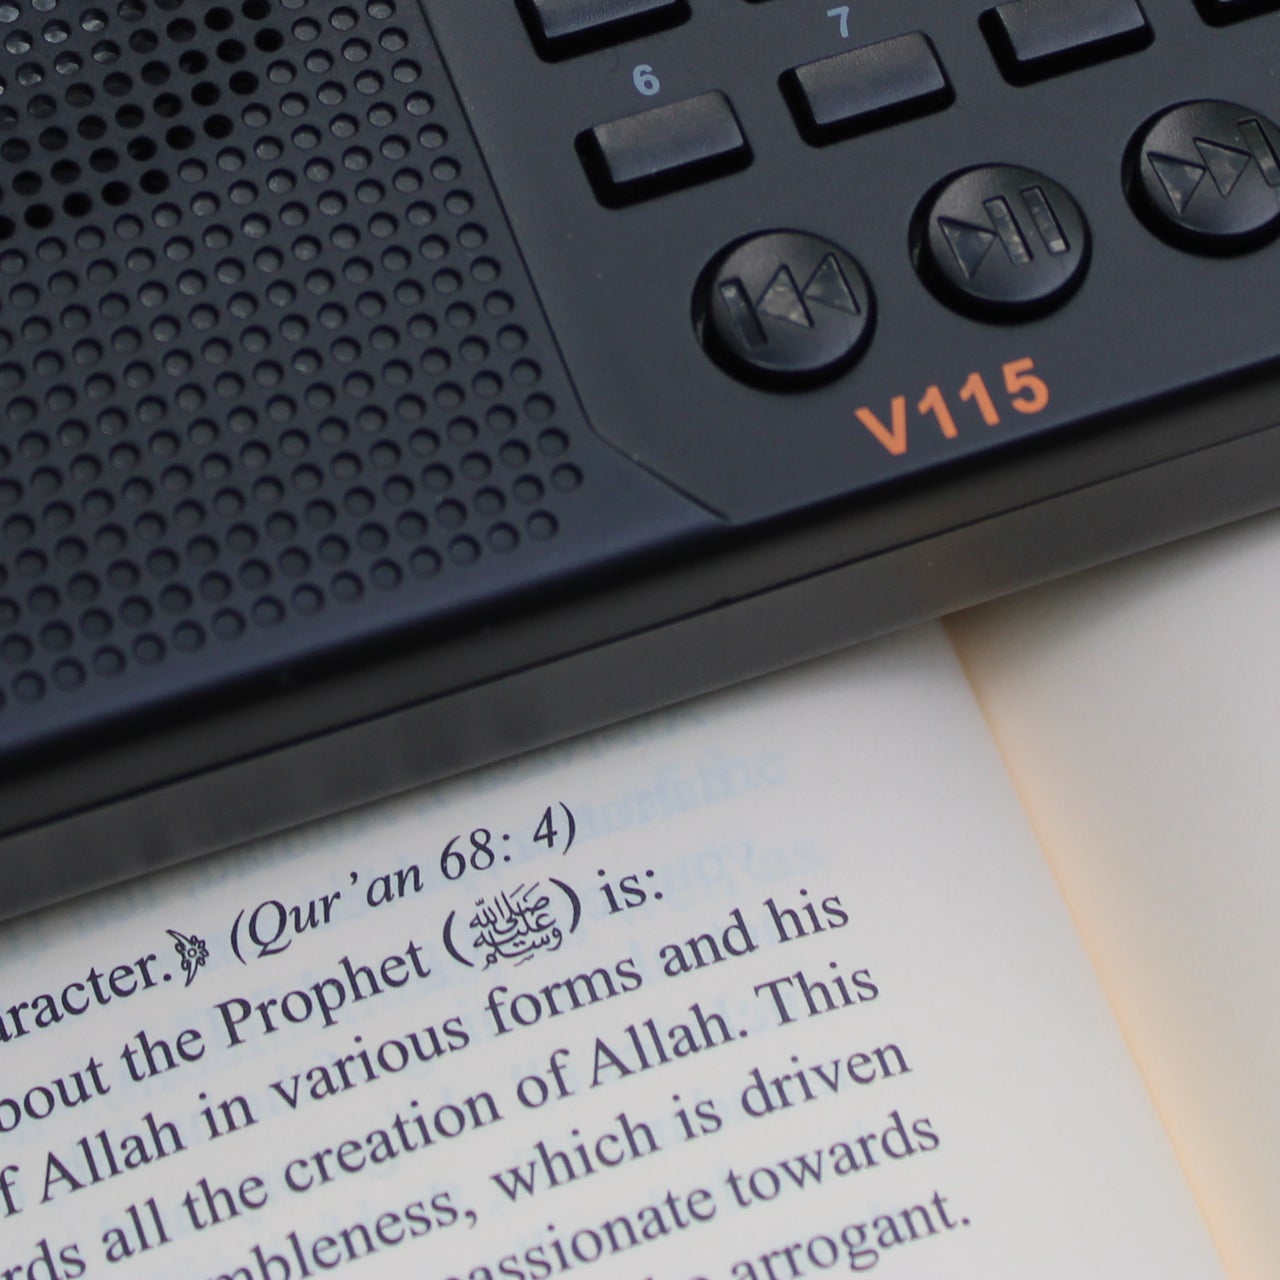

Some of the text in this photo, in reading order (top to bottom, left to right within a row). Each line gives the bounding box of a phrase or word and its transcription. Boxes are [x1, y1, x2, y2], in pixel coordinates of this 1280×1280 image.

[828, 6, 852, 38] 7
[632, 63, 661, 96] 6
[855, 357, 1050, 456] V115
[438, 826, 513, 882] 68:
[531, 800, 577, 857] 4)
[118, 1027, 207, 1084] the
[212, 939, 433, 1050] Prophet
[598, 868, 665, 916] is:
[38, 1110, 189, 1205] Allah
[199, 1094, 260, 1142] in
[267, 1015, 471, 1111] various
[483, 956, 644, 1038] forms
[657, 906, 761, 979] and
[761, 894, 850, 945] his
[100, 1196, 172, 1265] all
[180, 1175, 269, 1232] the
[283, 1090, 504, 1194] creation
[515, 1047, 575, 1110] of
[589, 1001, 749, 1090] Allah.
[752, 967, 881, 1027] This
[724, 1108, 941, 1209] towards
[730, 1190, 973, 1280] arrogant.
